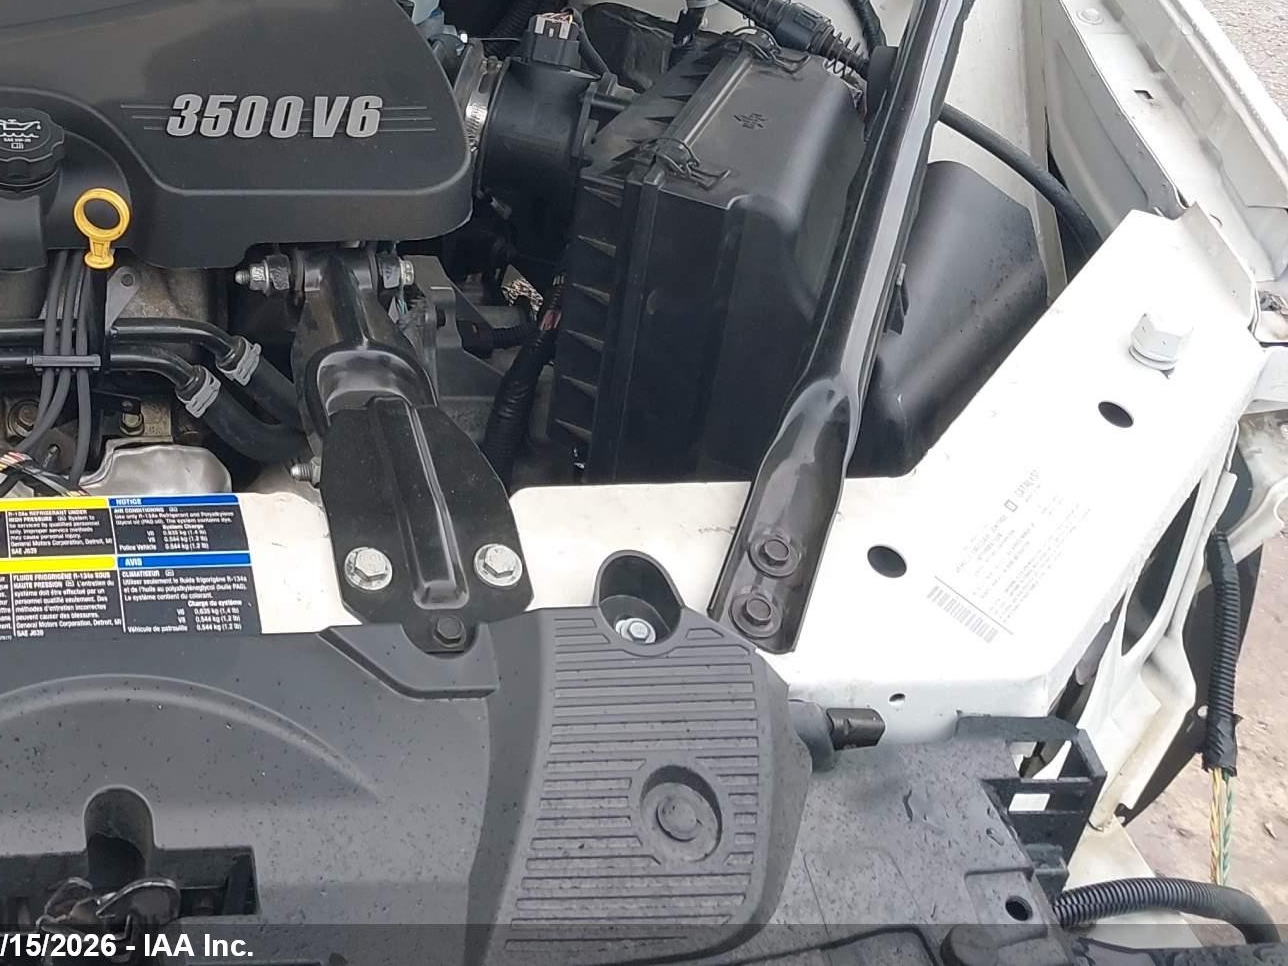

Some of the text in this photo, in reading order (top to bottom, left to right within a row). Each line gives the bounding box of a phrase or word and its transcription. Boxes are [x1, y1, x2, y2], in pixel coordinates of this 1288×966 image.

[167, 94, 383, 138] 3500 V6
[125, 558, 143, 566] AVIS
